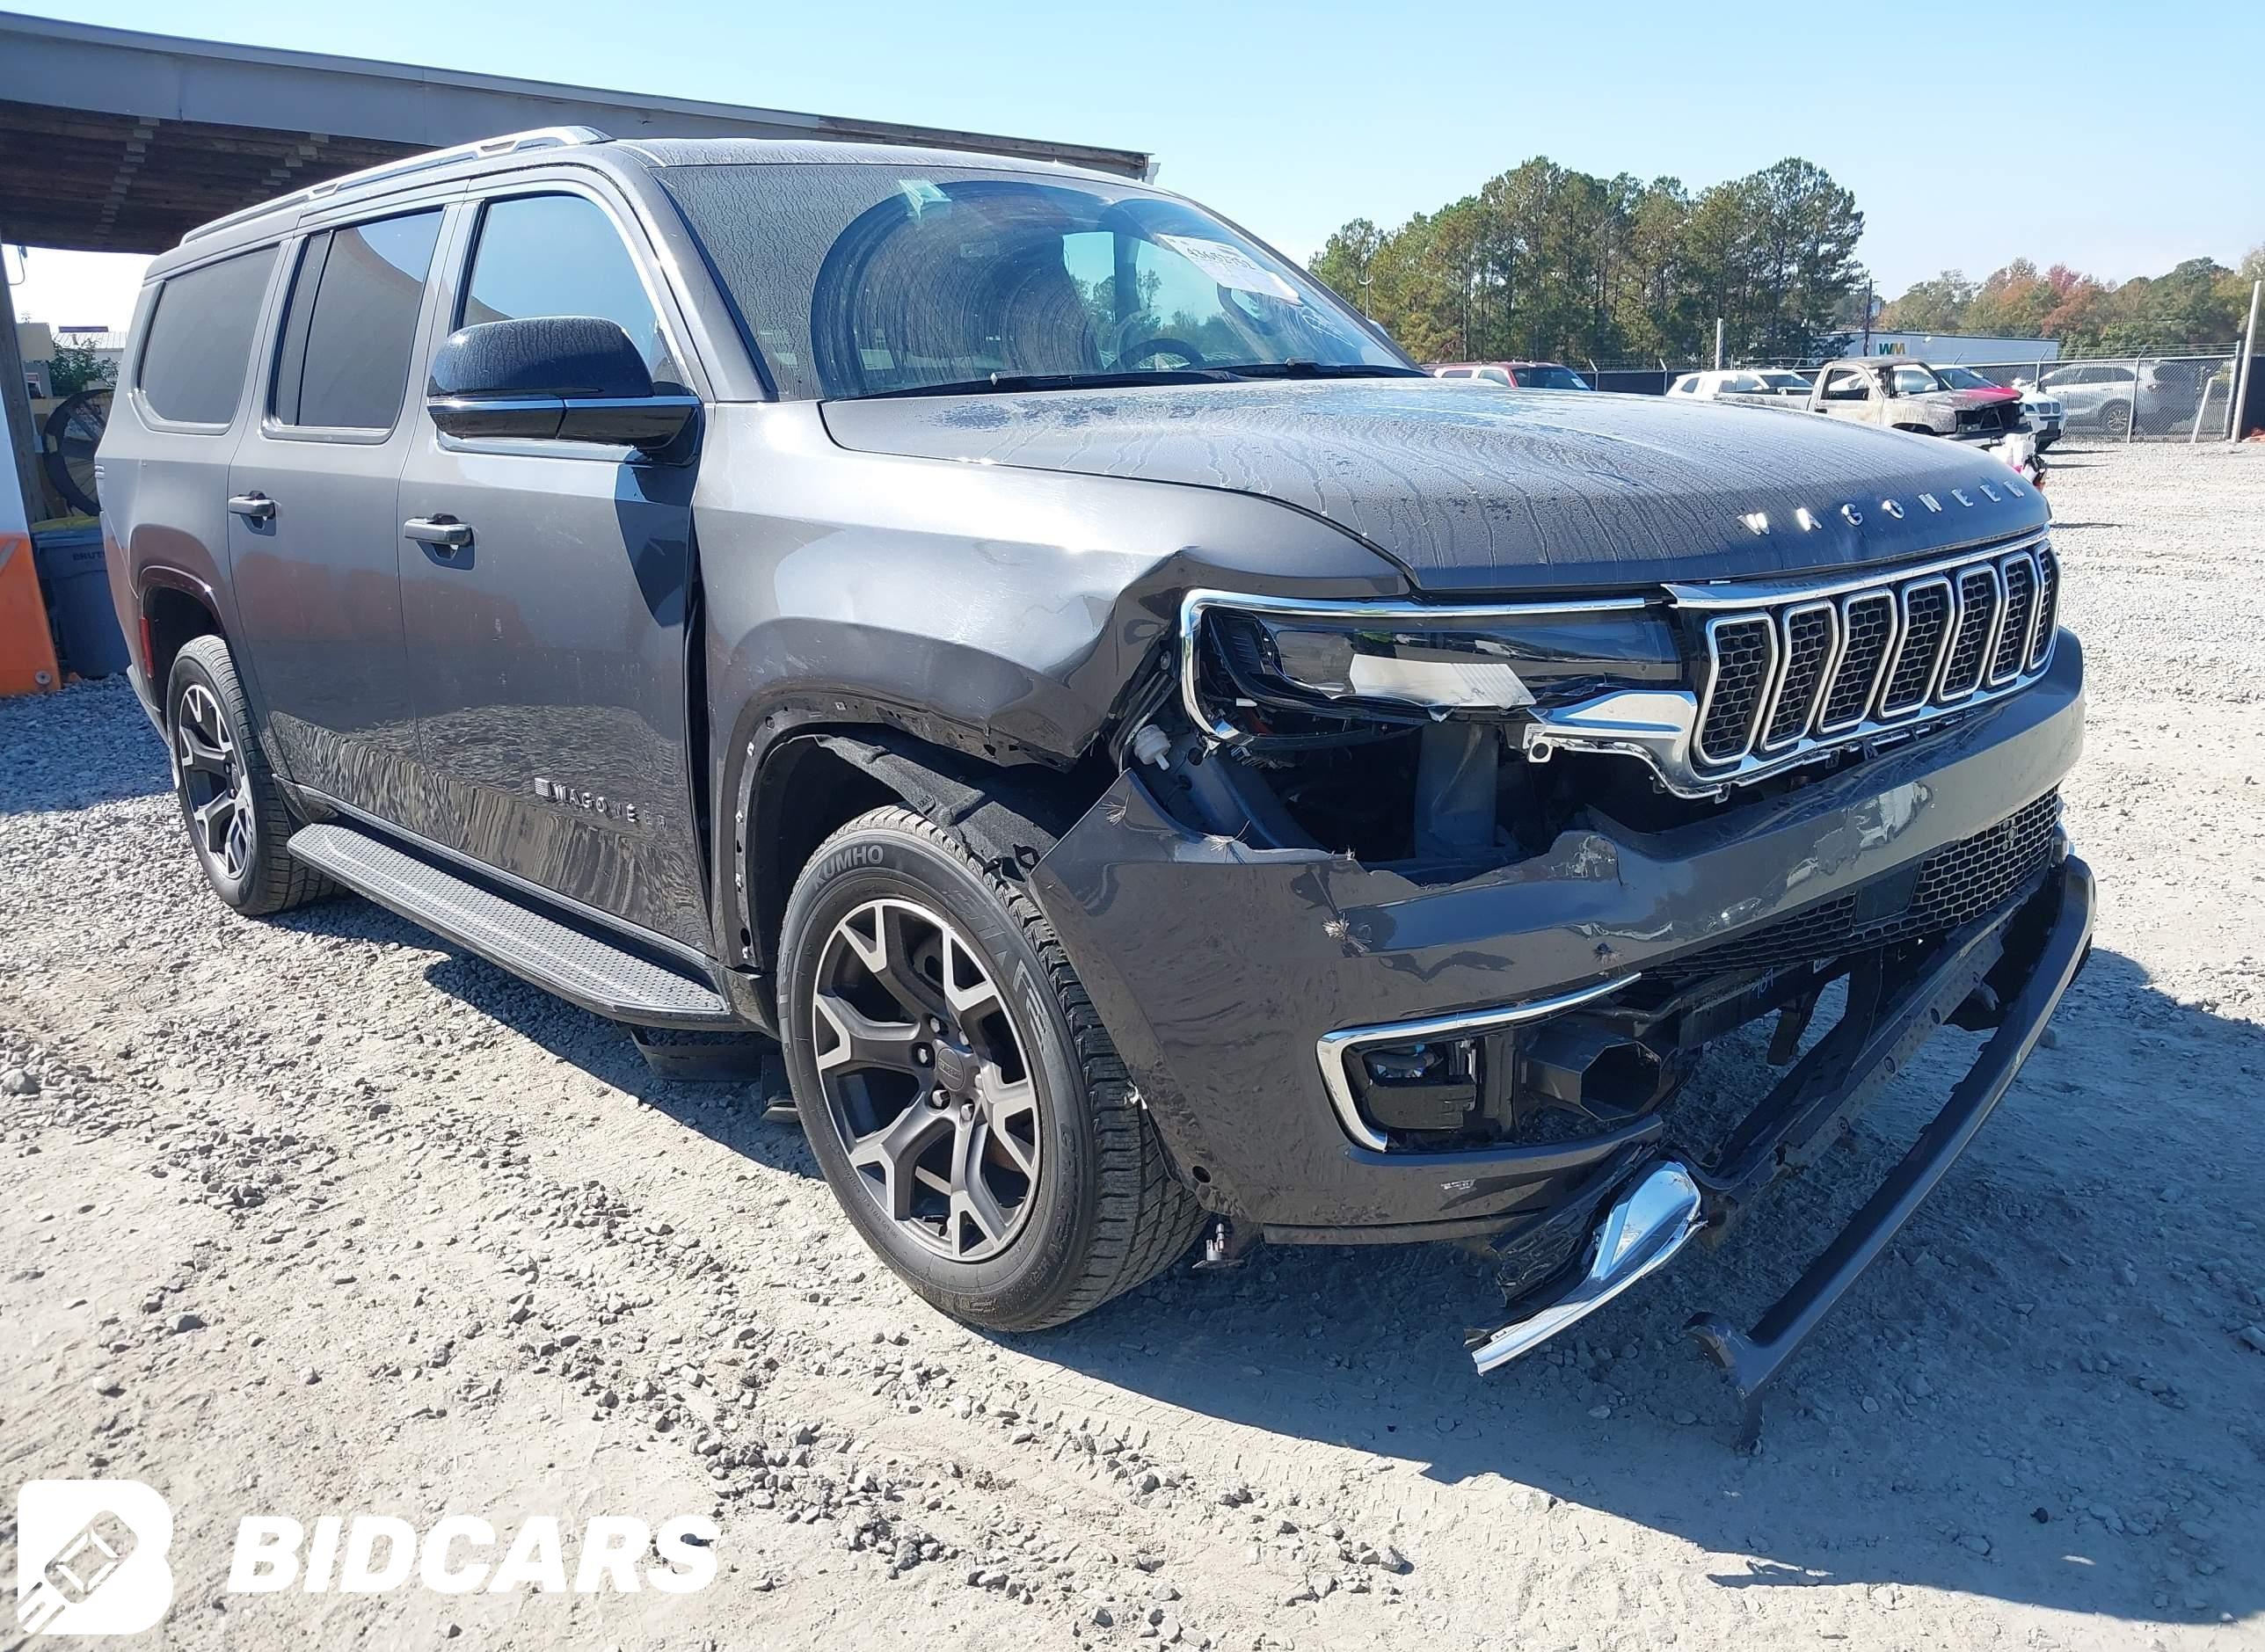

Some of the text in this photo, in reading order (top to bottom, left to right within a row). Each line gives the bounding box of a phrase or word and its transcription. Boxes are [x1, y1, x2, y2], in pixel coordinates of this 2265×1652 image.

[1879, 343, 1905, 355] WM
[1737, 480, 2025, 535] WAGONEER
[72, 549, 105, 561] BRUT
[552, 783, 666, 832] WAGONEER
[816, 844, 884, 891] KUMHO
